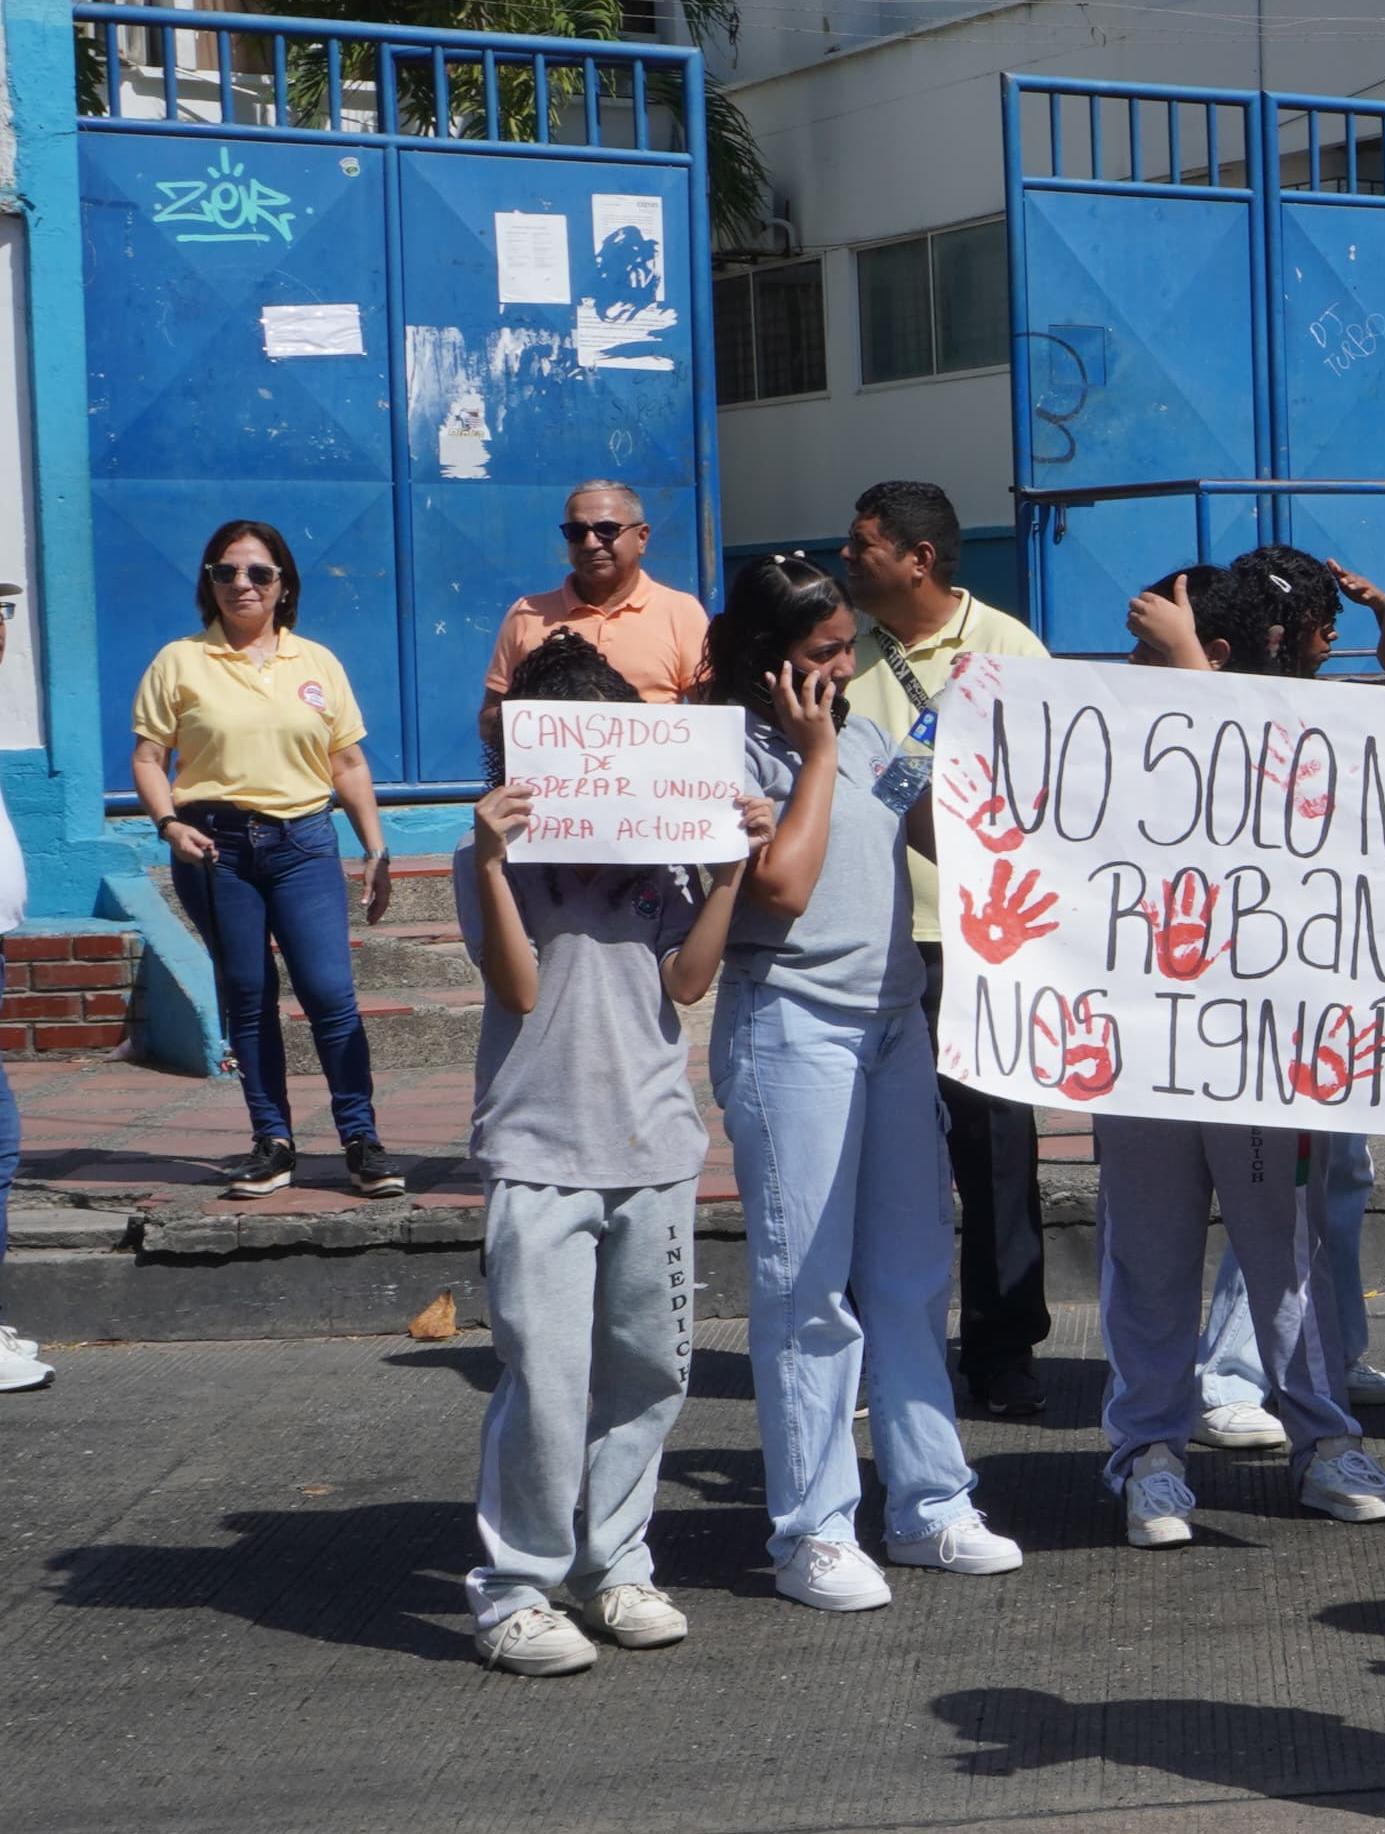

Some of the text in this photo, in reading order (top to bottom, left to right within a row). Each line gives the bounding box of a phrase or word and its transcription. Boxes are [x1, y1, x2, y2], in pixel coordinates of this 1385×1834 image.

[511, 709, 692, 750] CANSADOS
[580, 753, 617, 775] DE
[989, 699, 1114, 843] NO
[1138, 710, 1338, 860] SOLO
[652, 777, 742, 800] UNIDOS
[527, 811, 595, 844] PARA
[975, 974, 1124, 1091] NOS
